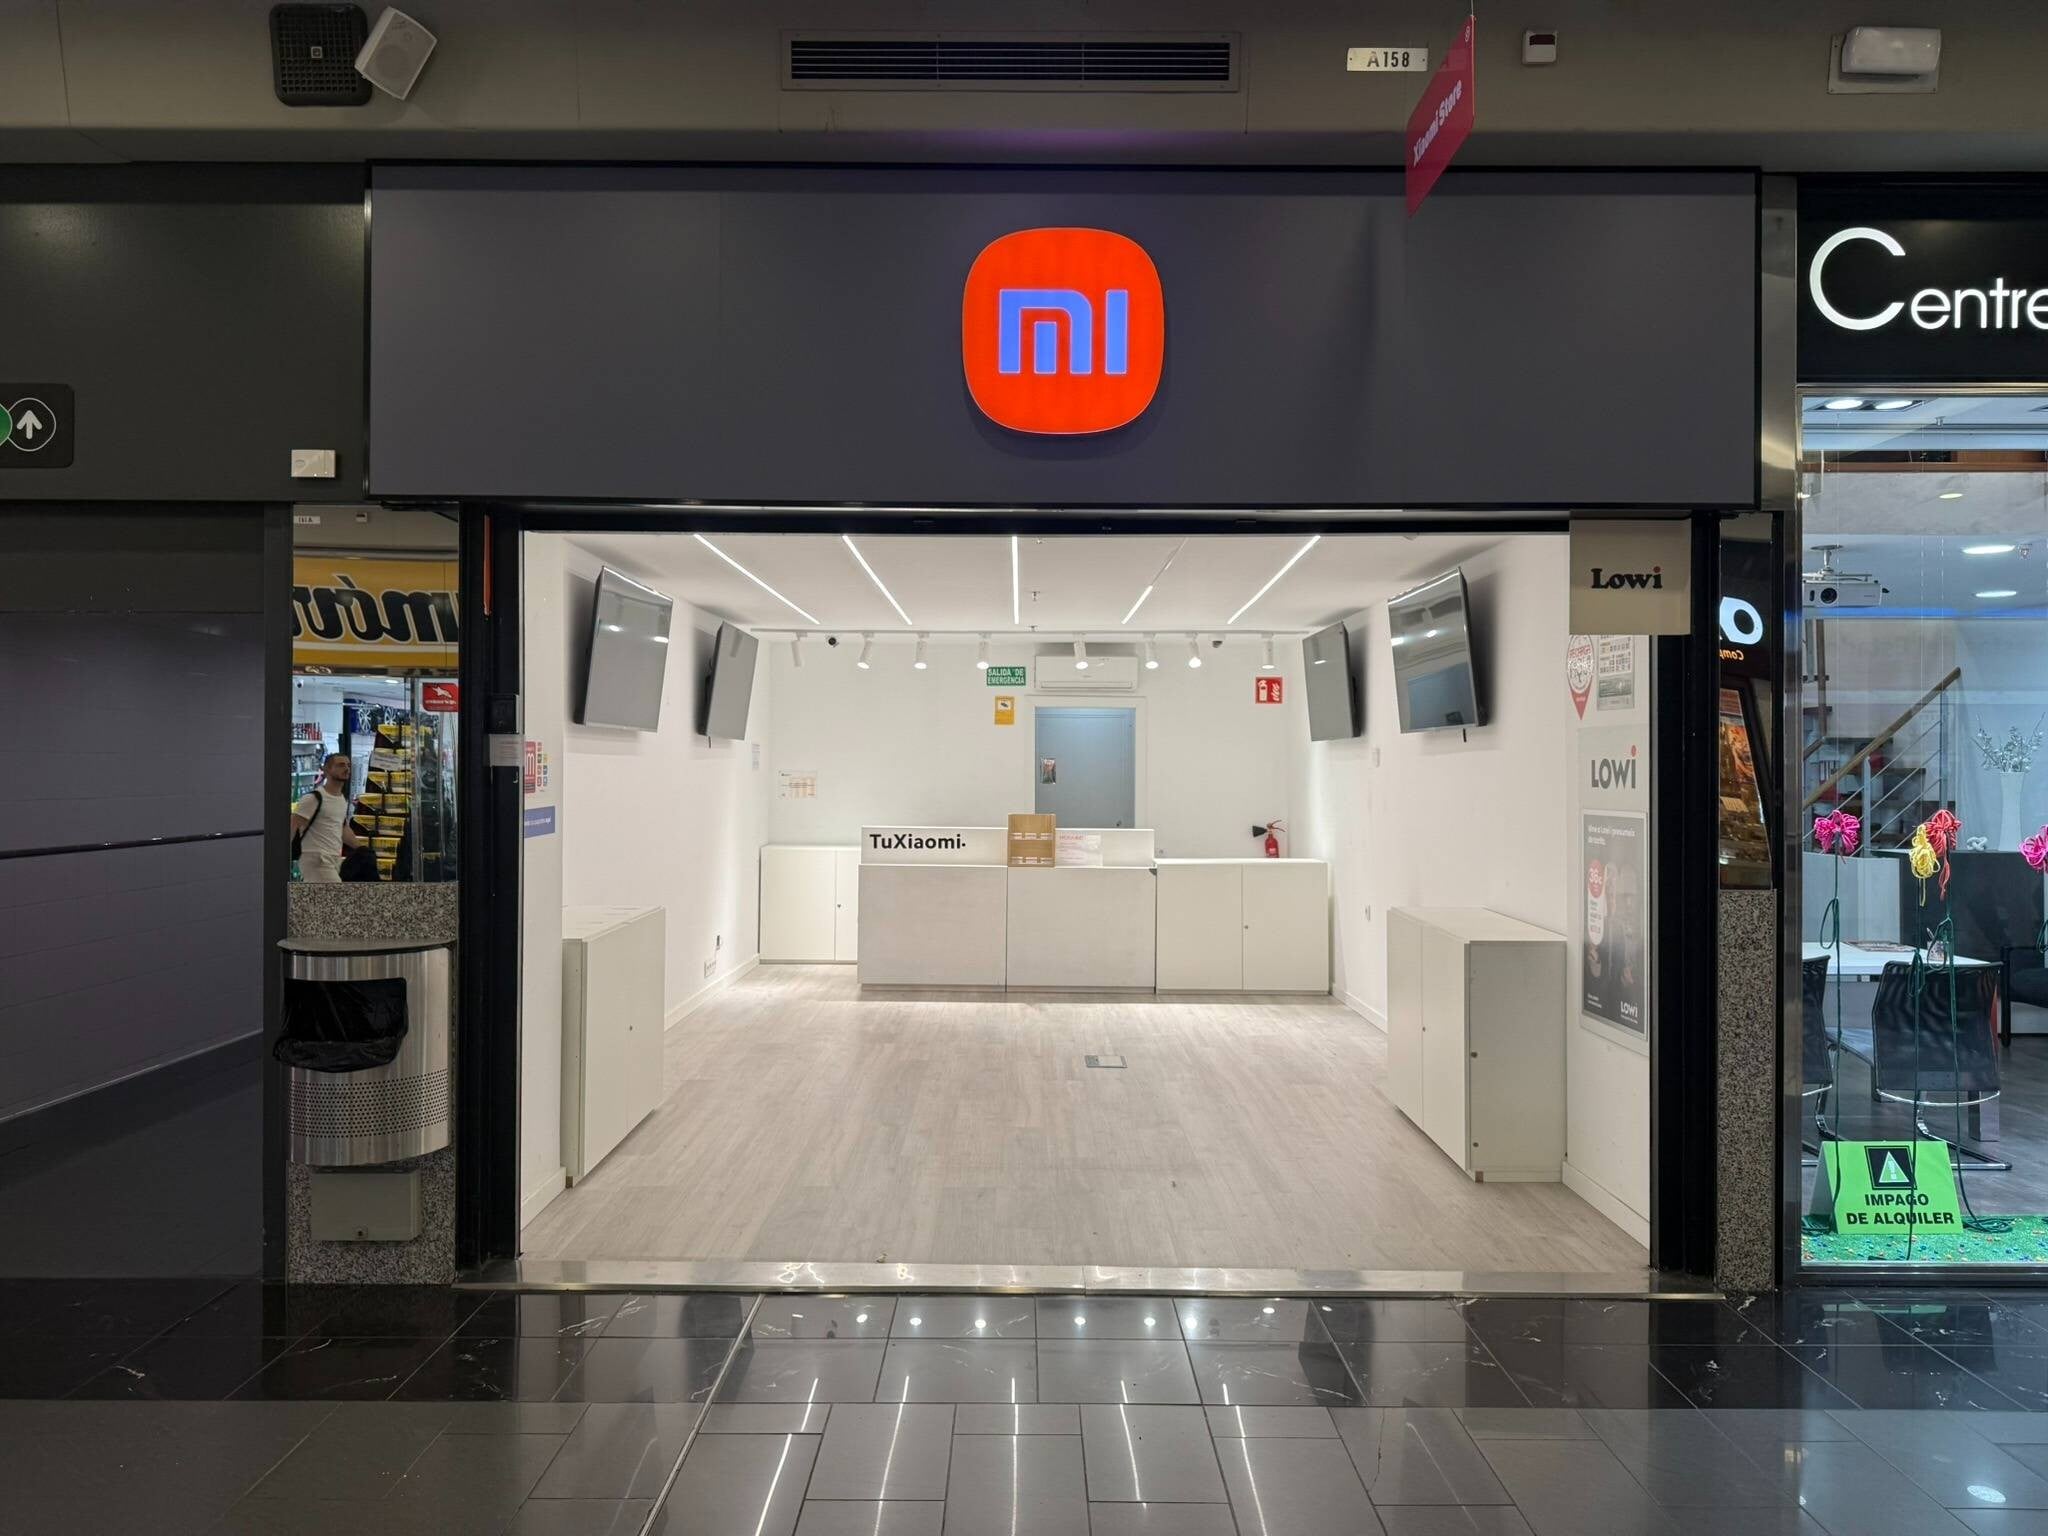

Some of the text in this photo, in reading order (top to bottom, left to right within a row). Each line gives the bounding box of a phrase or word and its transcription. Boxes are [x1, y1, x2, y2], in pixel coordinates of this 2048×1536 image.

[1367, 51, 1410, 68] A158
[1413, 79, 1462, 167] Xiaomi Store
[1590, 566, 1663, 589] Lowi
[988, 668, 1024, 676] SALIDA DE
[1865, 1193, 1929, 1206] IMPAGO
[1846, 1212, 1955, 1226] DE ALQUILER
